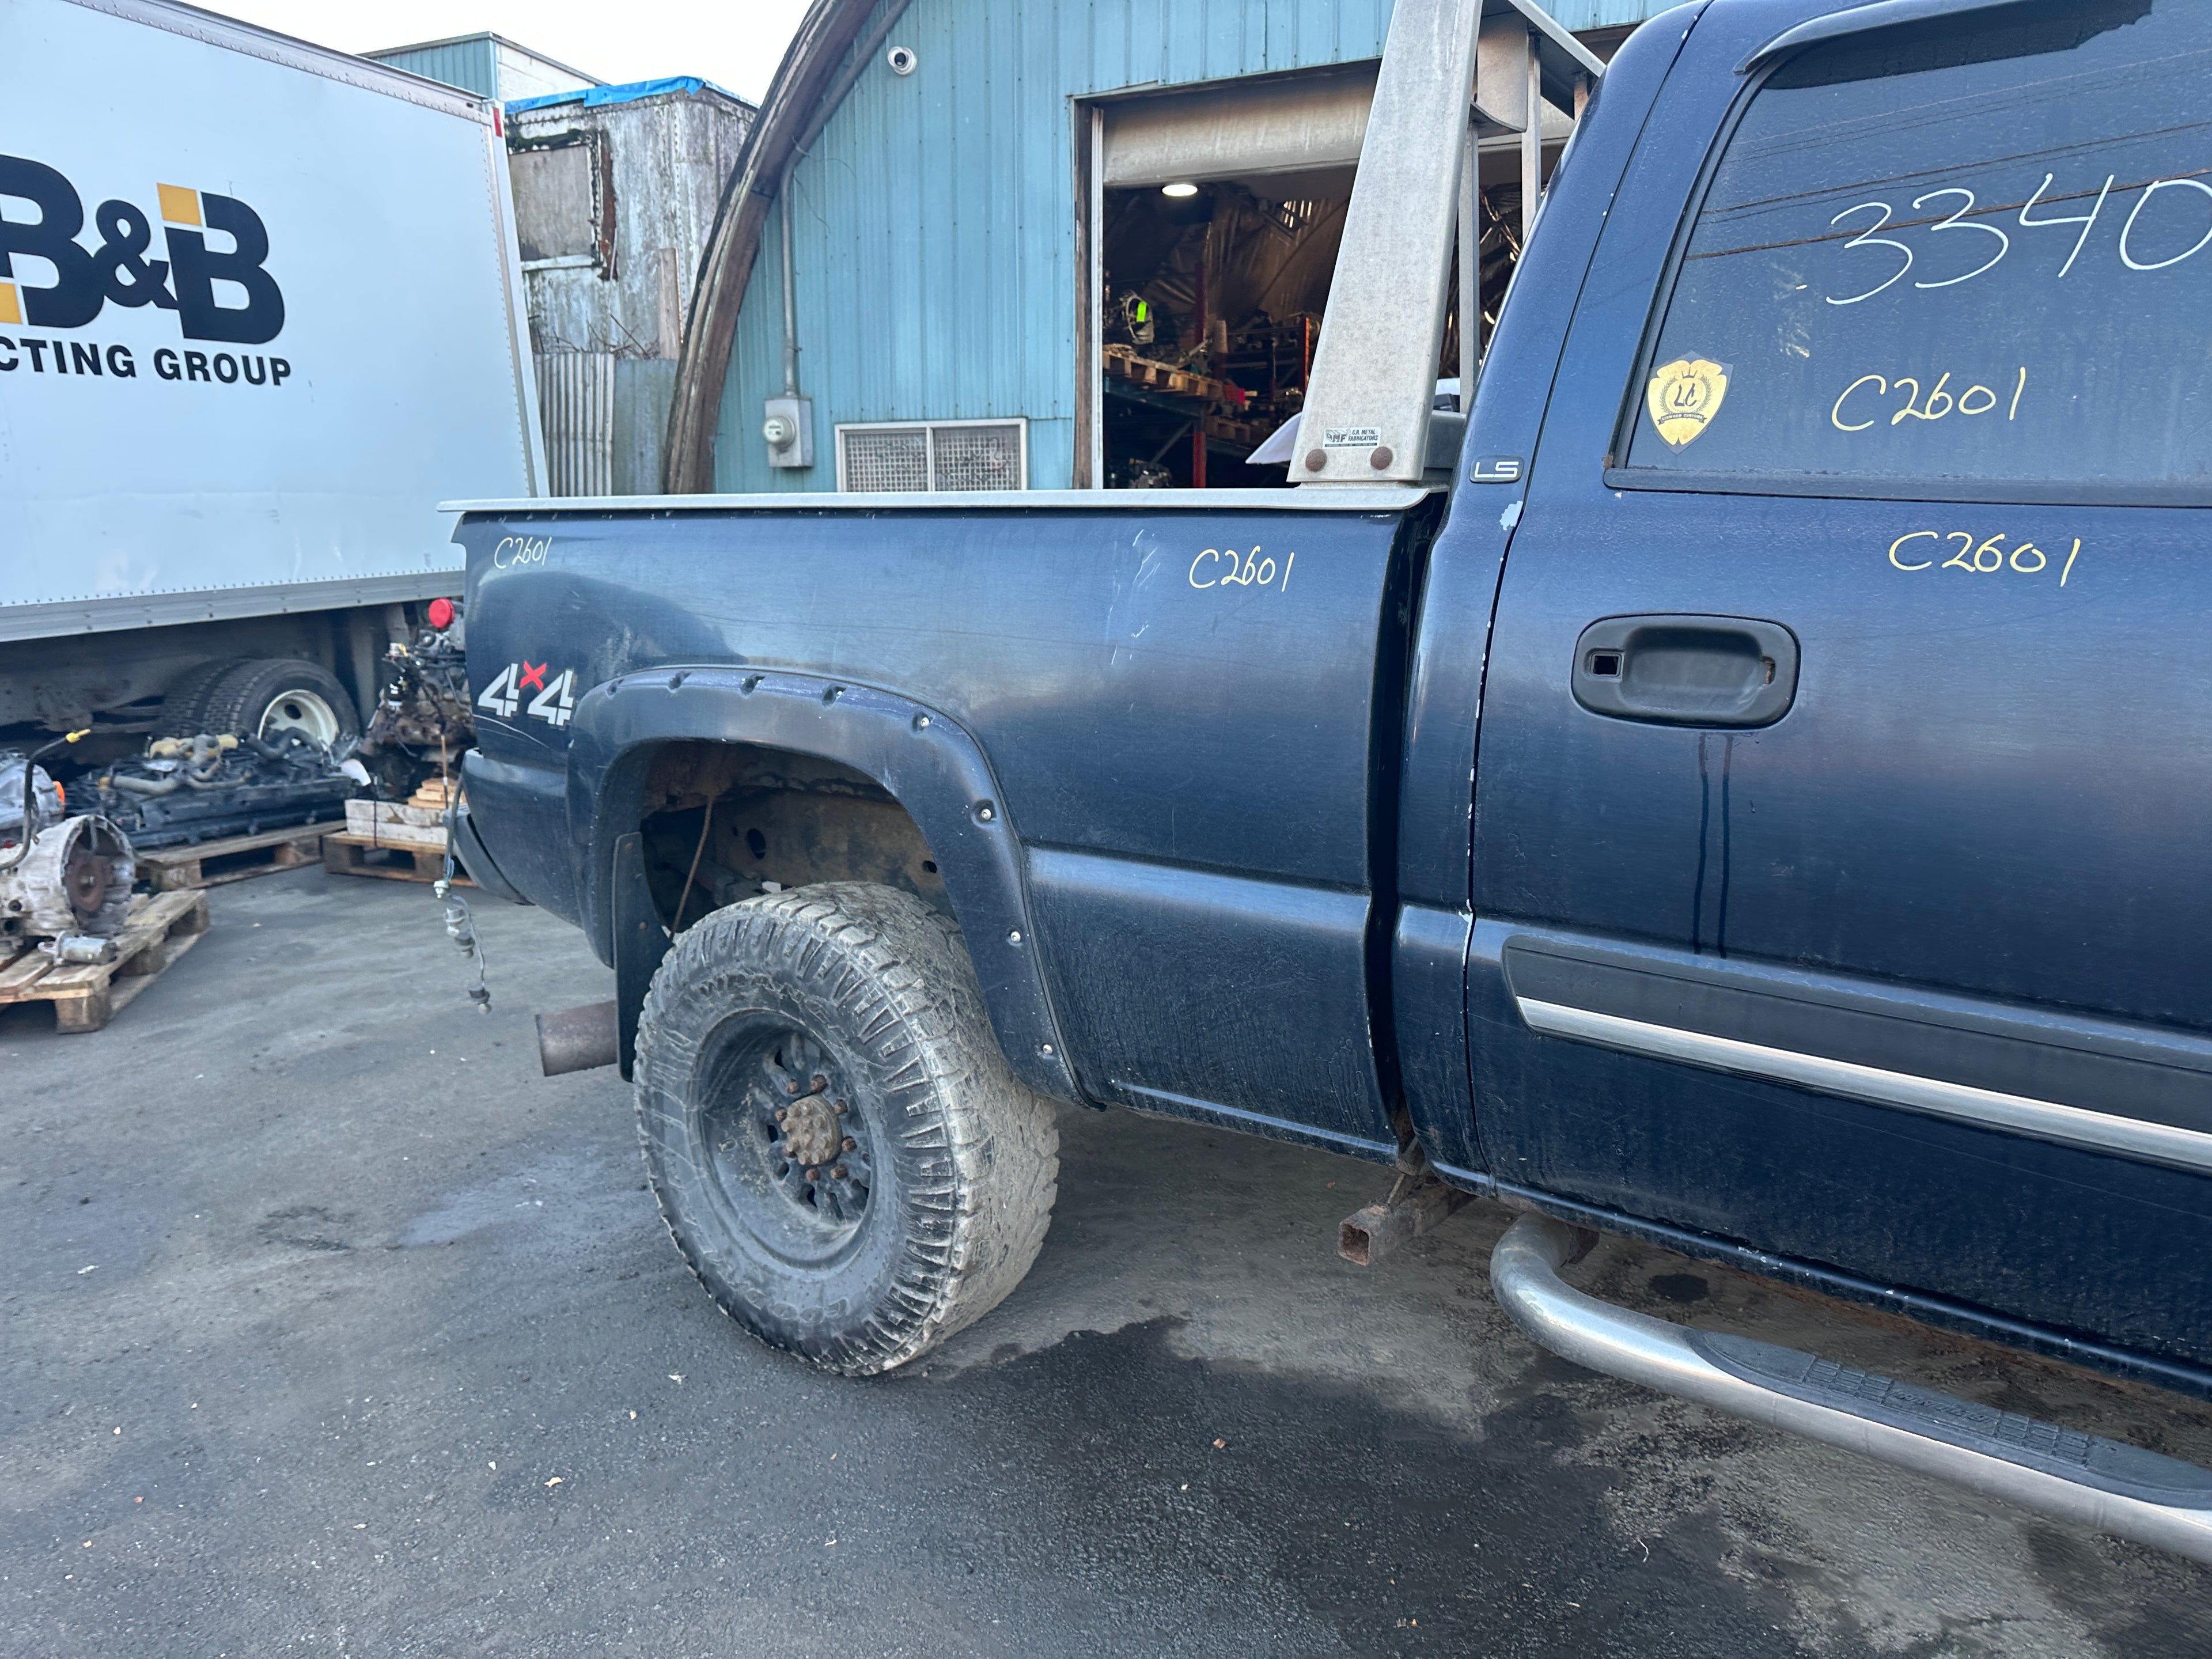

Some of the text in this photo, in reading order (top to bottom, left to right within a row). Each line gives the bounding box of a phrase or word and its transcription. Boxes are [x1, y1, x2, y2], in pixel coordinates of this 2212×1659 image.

[0, 154, 286, 344] B&B
[1825, 173, 2212, 305] 3340
[0, 336, 291, 387] CTING GROUP
[1831, 366, 2026, 431] C2601
[1474, 461, 1519, 478] LS
[494, 536, 552, 569] C2601
[1189, 545, 1295, 593] C2601
[1889, 531, 2081, 588] C2601
